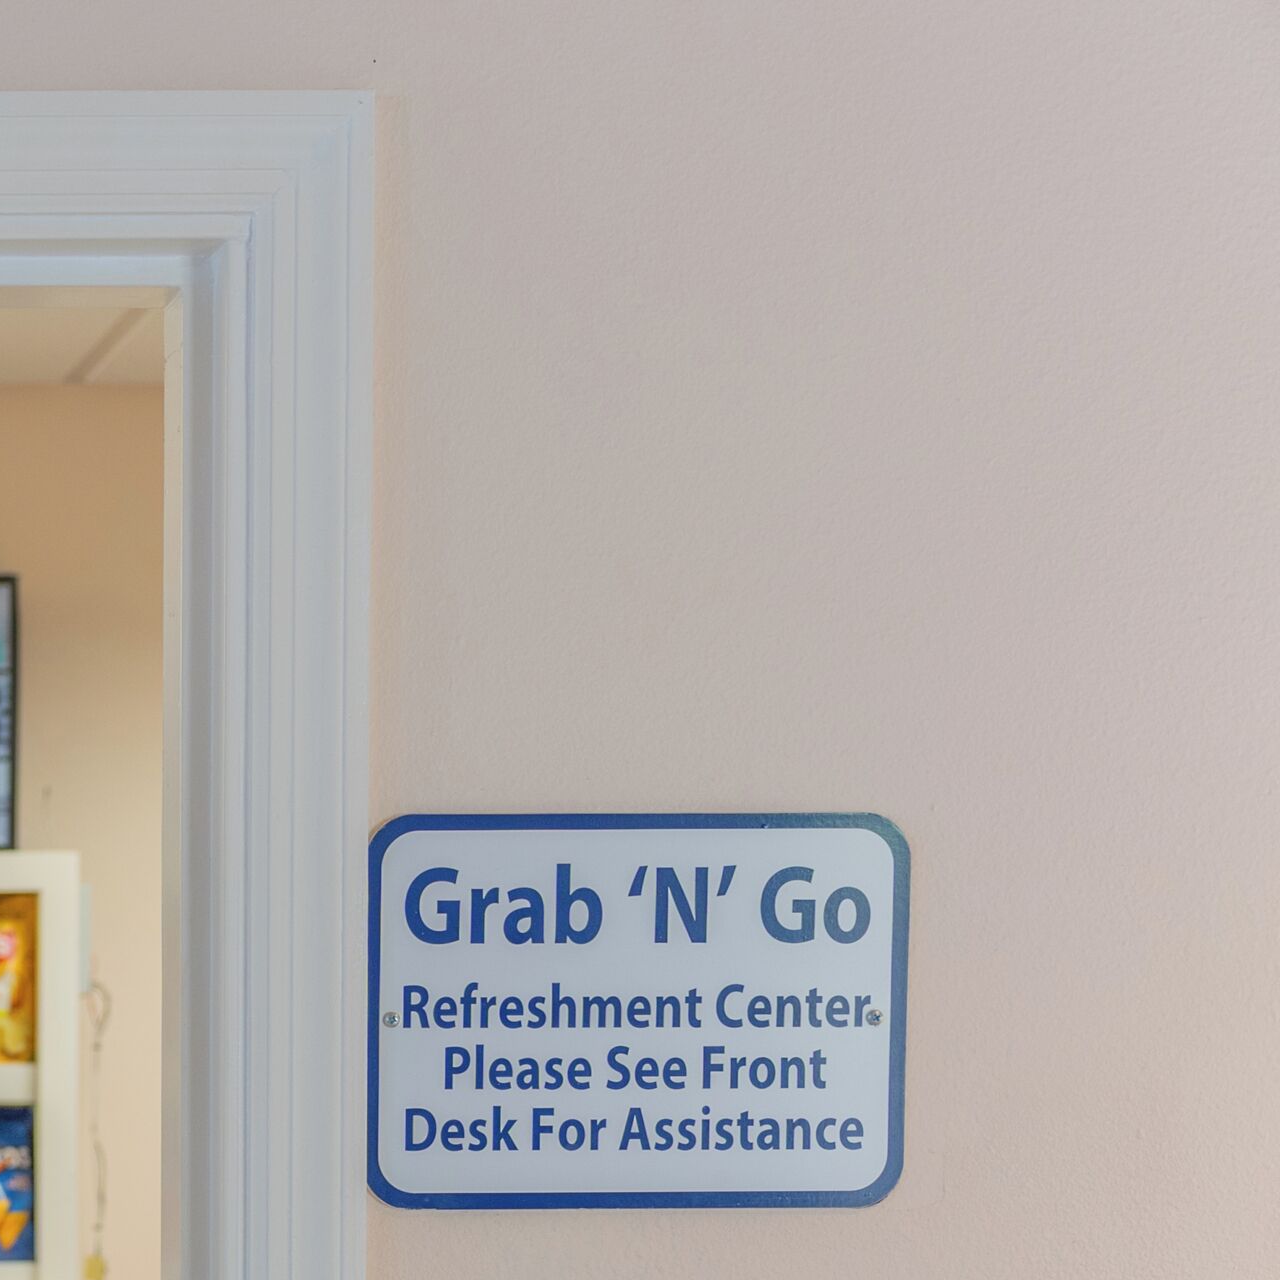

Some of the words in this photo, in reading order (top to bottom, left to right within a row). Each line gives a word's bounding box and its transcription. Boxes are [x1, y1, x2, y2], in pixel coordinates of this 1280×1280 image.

[403, 863, 603, 945] Grab
[759, 865, 872, 945] Go
[402, 981, 703, 1030] Refreshment
[715, 983, 873, 1030] Center
[443, 1043, 593, 1092] Please
[607, 1045, 689, 1092] See
[702, 1044, 828, 1090] Front
[403, 1104, 518, 1152] Desk
[530, 1106, 609, 1152] For
[619, 1105, 865, 1152] Assistance
